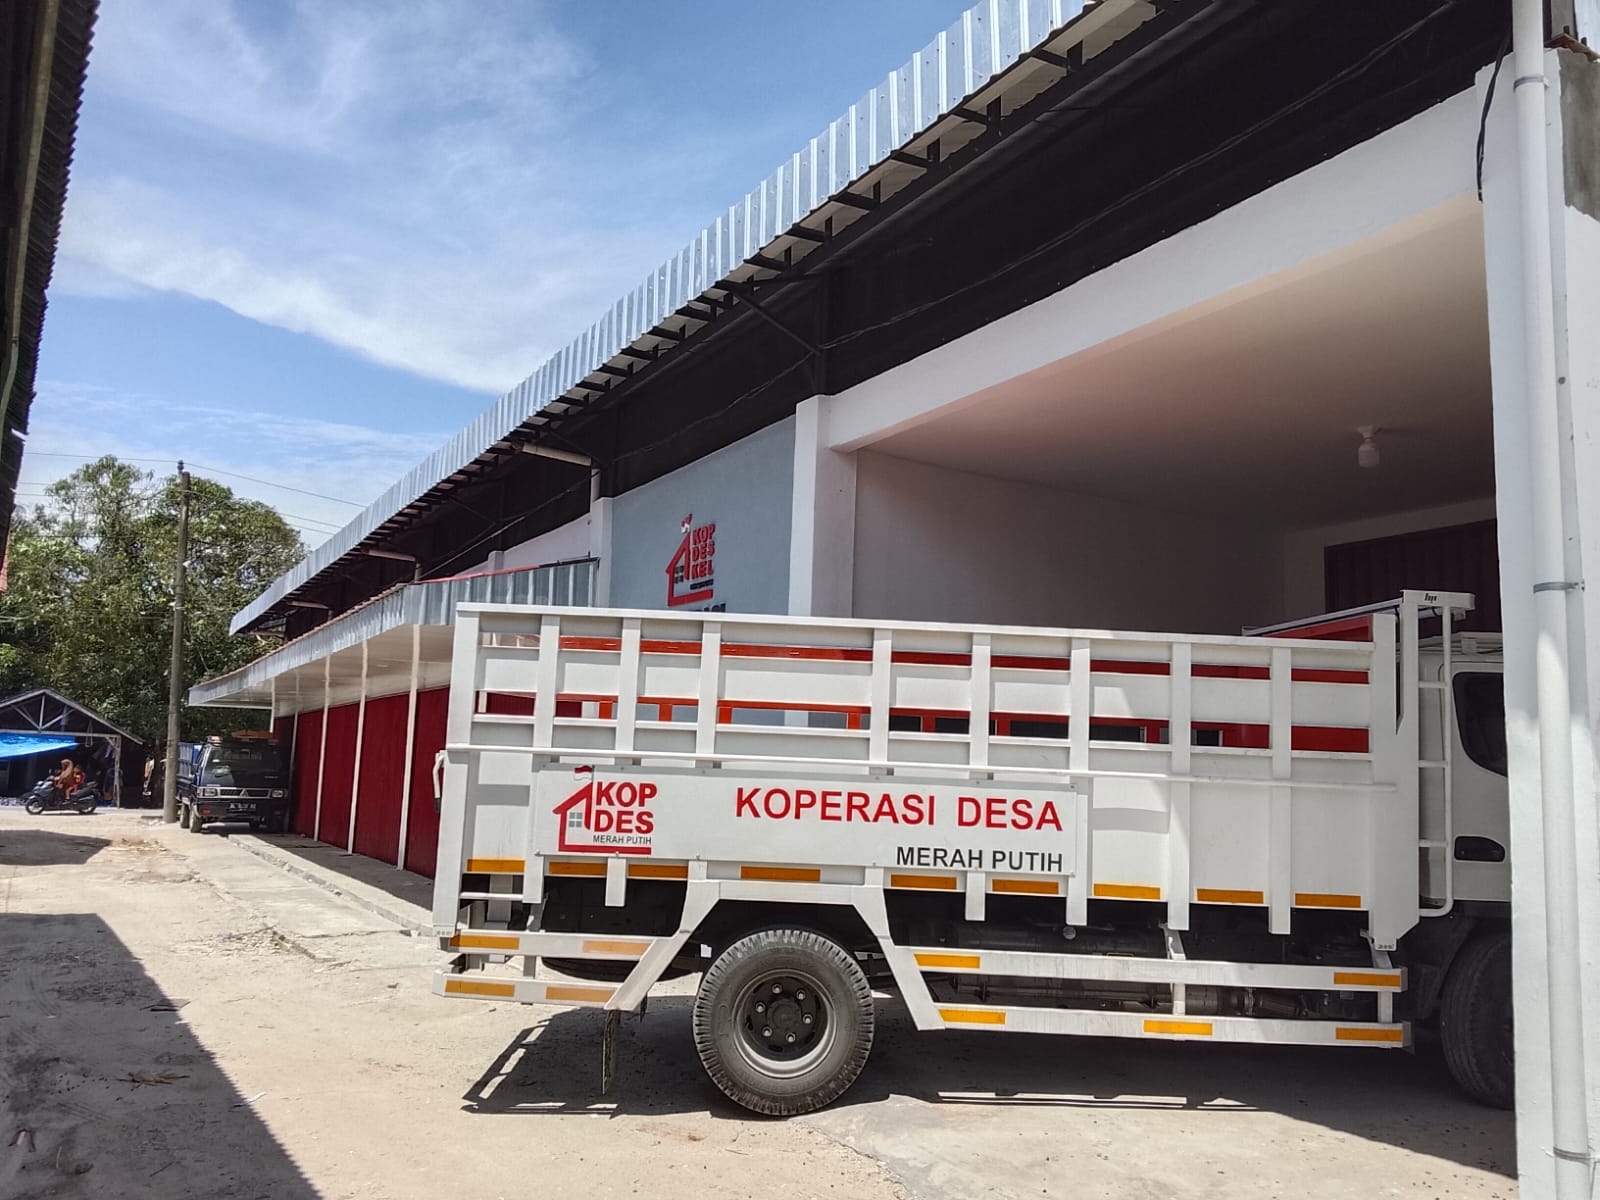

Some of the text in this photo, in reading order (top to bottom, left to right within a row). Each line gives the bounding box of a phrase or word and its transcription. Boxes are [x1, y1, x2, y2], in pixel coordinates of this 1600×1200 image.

[692, 524, 716, 545] KOP
[692, 540, 715, 561] DES
[691, 560, 714, 580] KEL
[596, 781, 658, 807] KOP
[736, 787, 1063, 832] KOPERASI DESA
[594, 809, 654, 834] DES
[593, 834, 652, 845] MERAH PUTIH
[896, 846, 1063, 872] MERAH PUTIH
